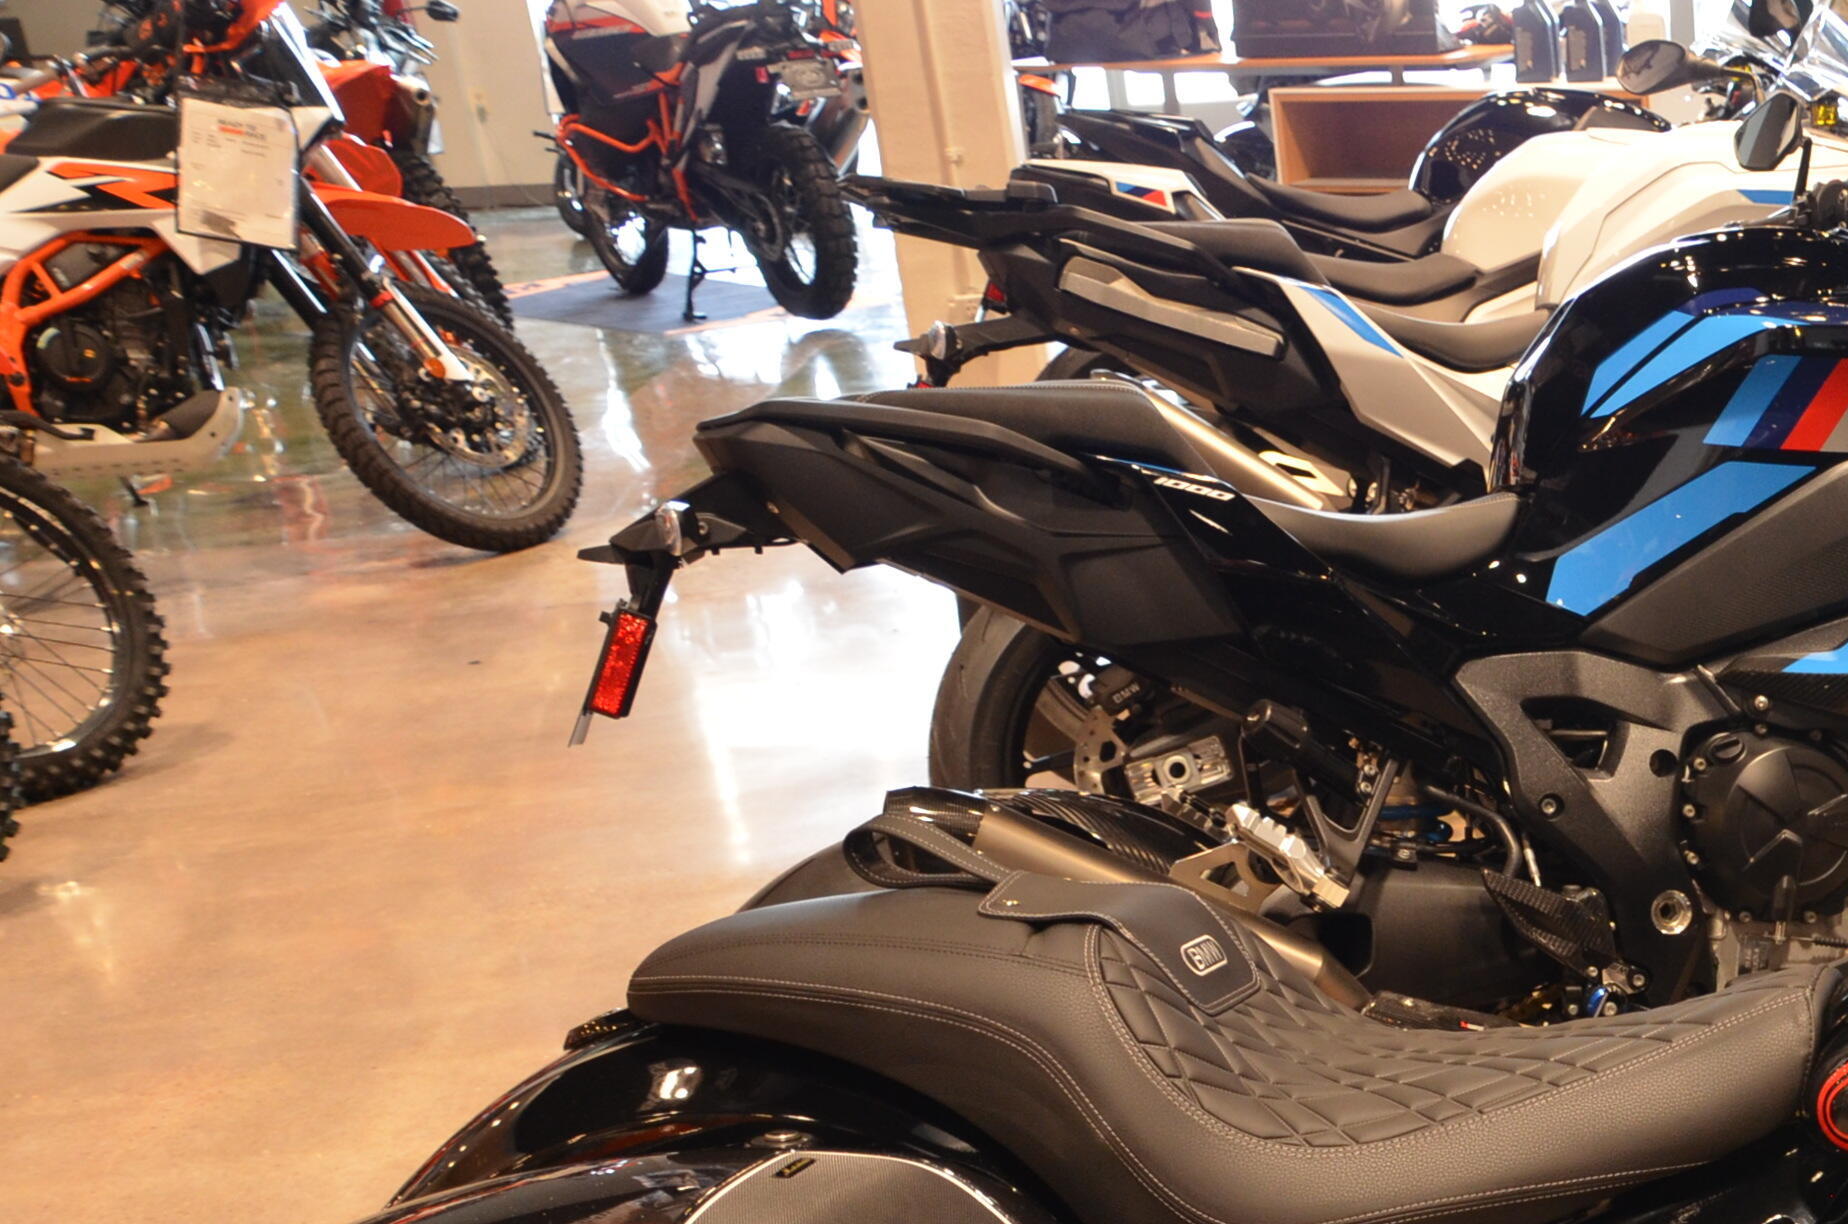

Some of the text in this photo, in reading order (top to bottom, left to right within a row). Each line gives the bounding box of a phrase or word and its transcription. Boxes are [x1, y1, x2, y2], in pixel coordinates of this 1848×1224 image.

[1153, 476, 1236, 502] 1000
[1112, 682, 1140, 704] BMW
[1187, 941, 1222, 970] BMW
